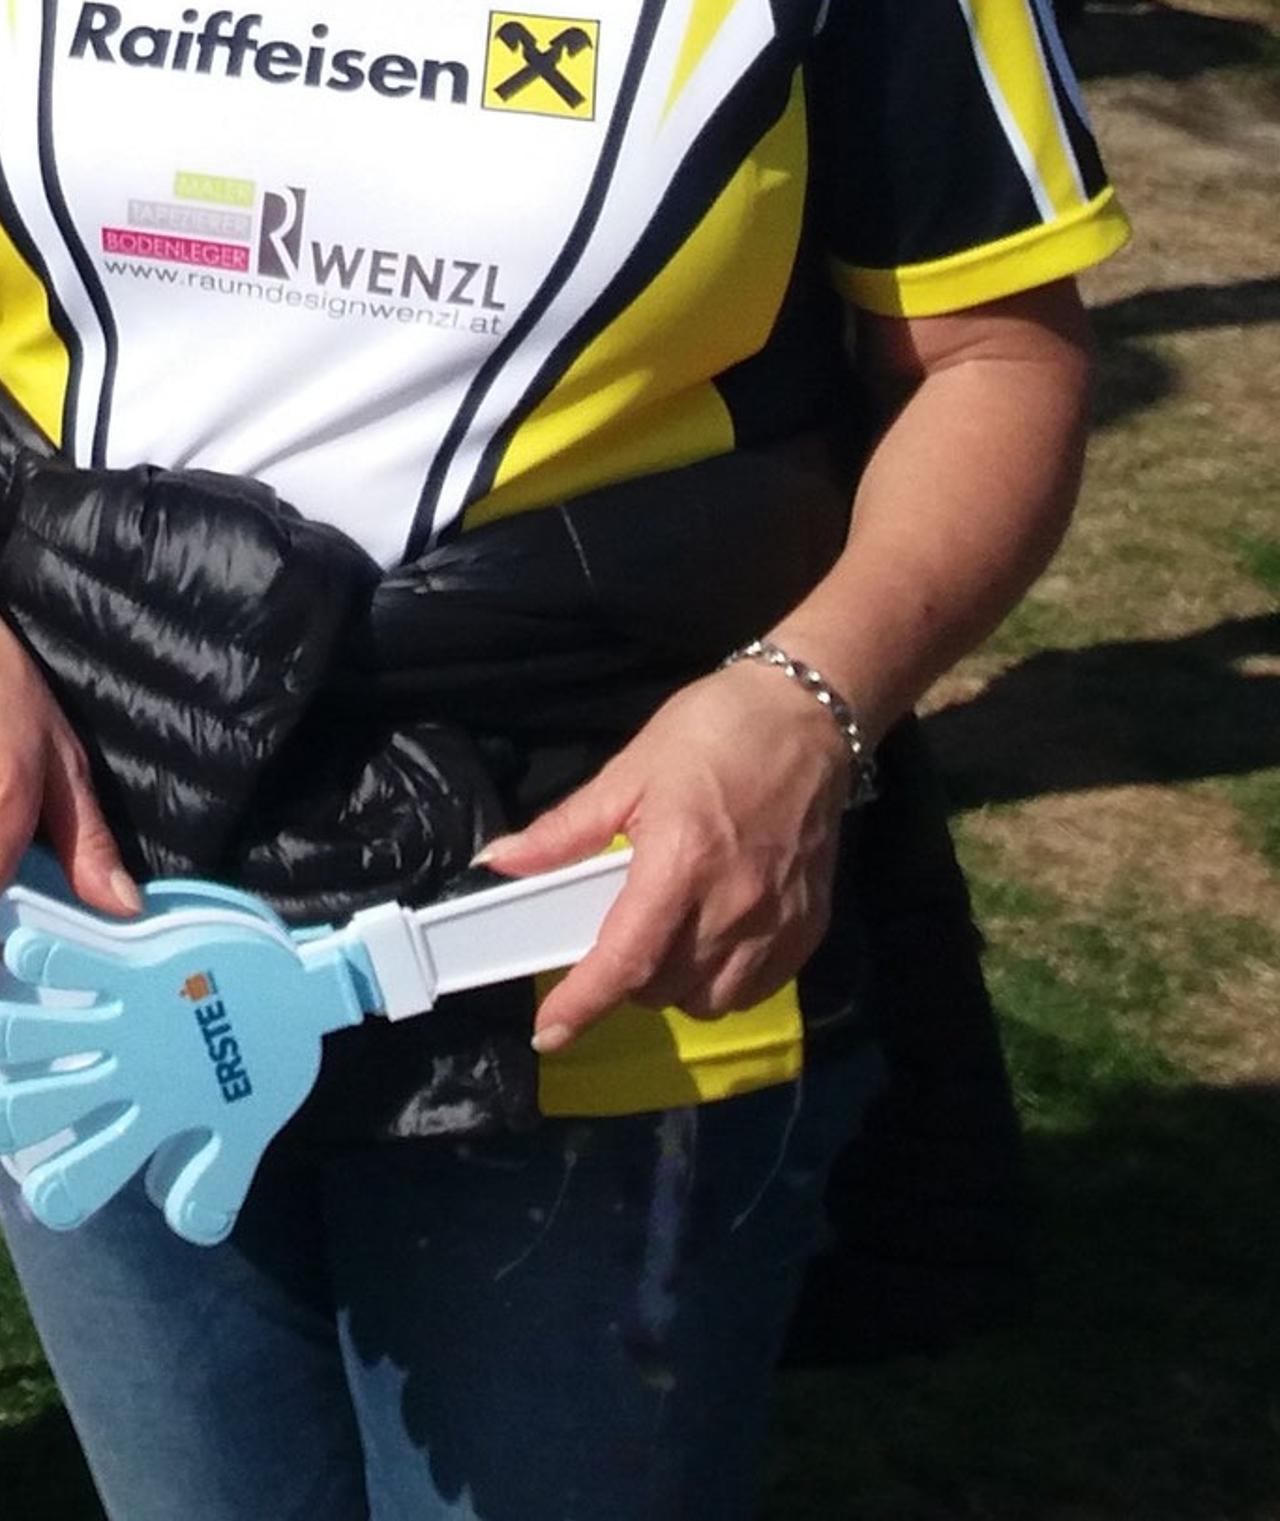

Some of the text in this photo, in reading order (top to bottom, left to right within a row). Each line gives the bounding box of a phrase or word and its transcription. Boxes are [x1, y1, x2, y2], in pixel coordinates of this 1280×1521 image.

[68, 1, 471, 105] Raiffeisen
[104, 231, 248, 268] BODENLEGER
[311, 241, 506, 311] WENZL
[102, 259, 503, 337] www.raumdesignwenzl.at
[194, 999, 253, 1104] ERSTE
